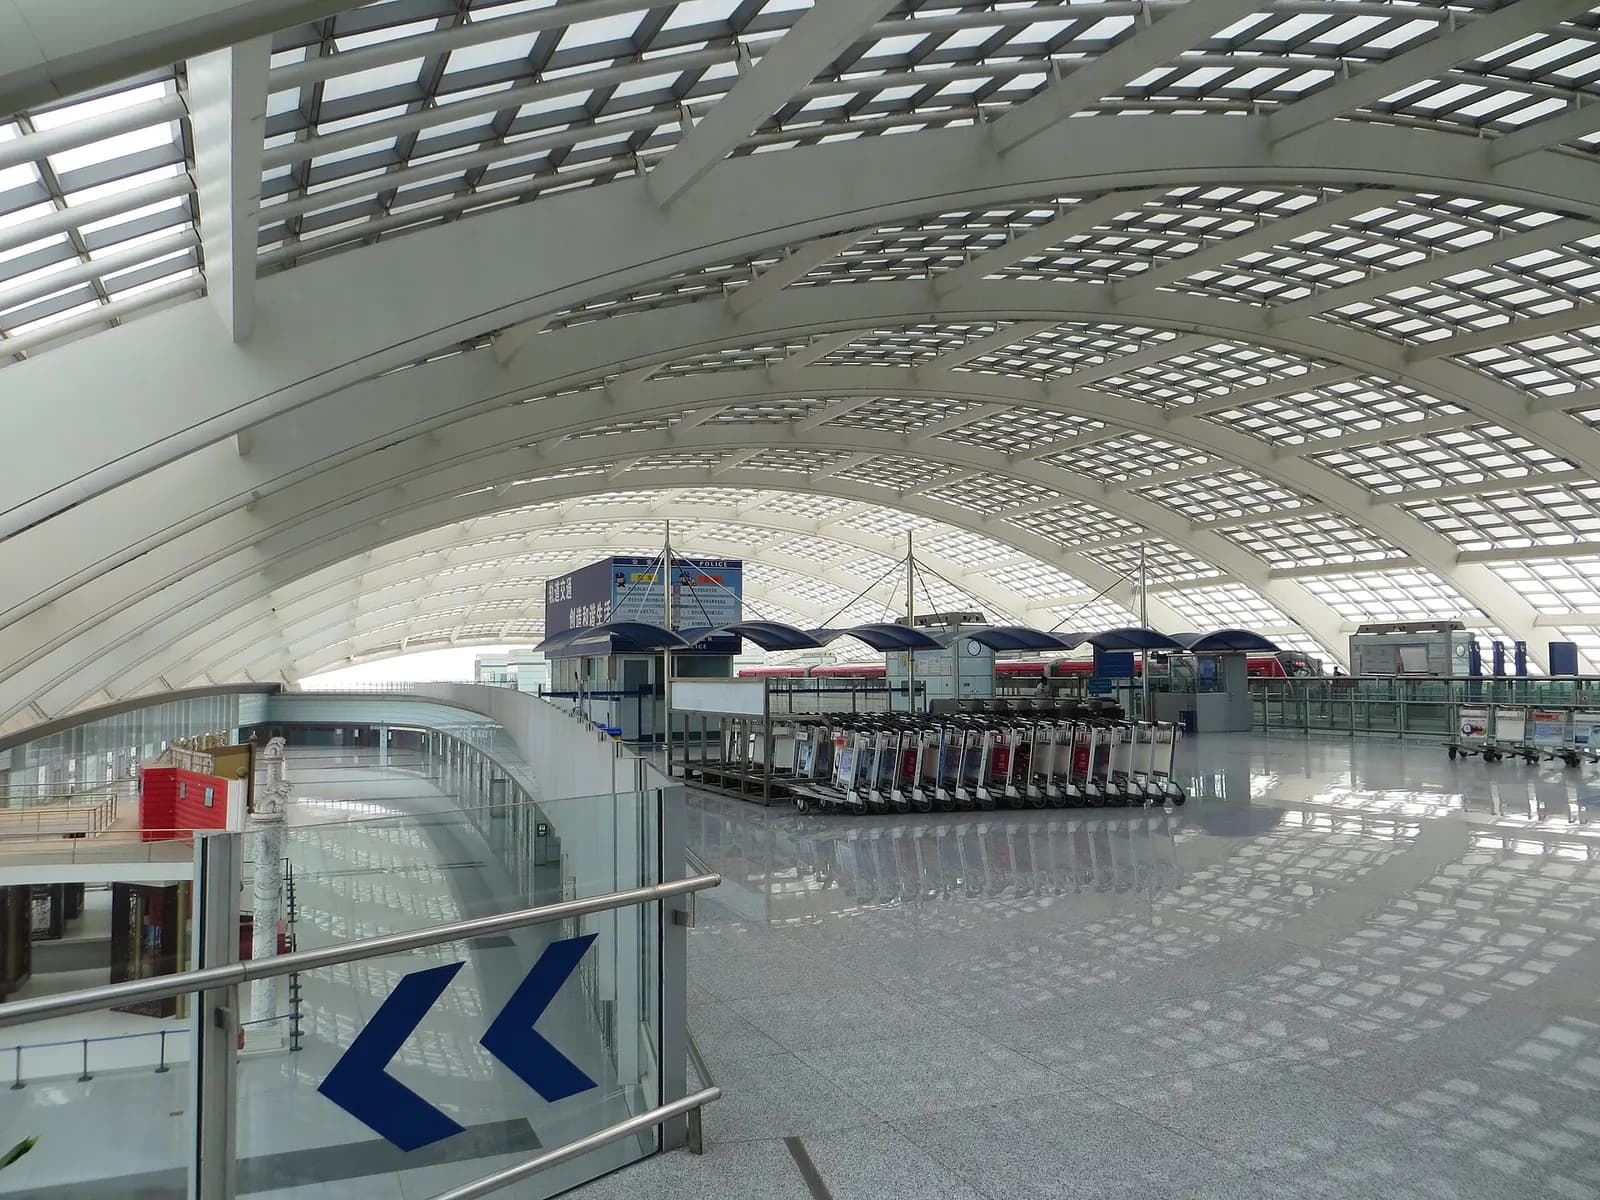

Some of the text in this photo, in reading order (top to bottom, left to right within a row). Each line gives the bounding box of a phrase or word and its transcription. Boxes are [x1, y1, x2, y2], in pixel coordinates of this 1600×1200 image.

[548, 577, 572, 604] 轨道交通
[569, 599, 611, 629] 创造和谐生活
